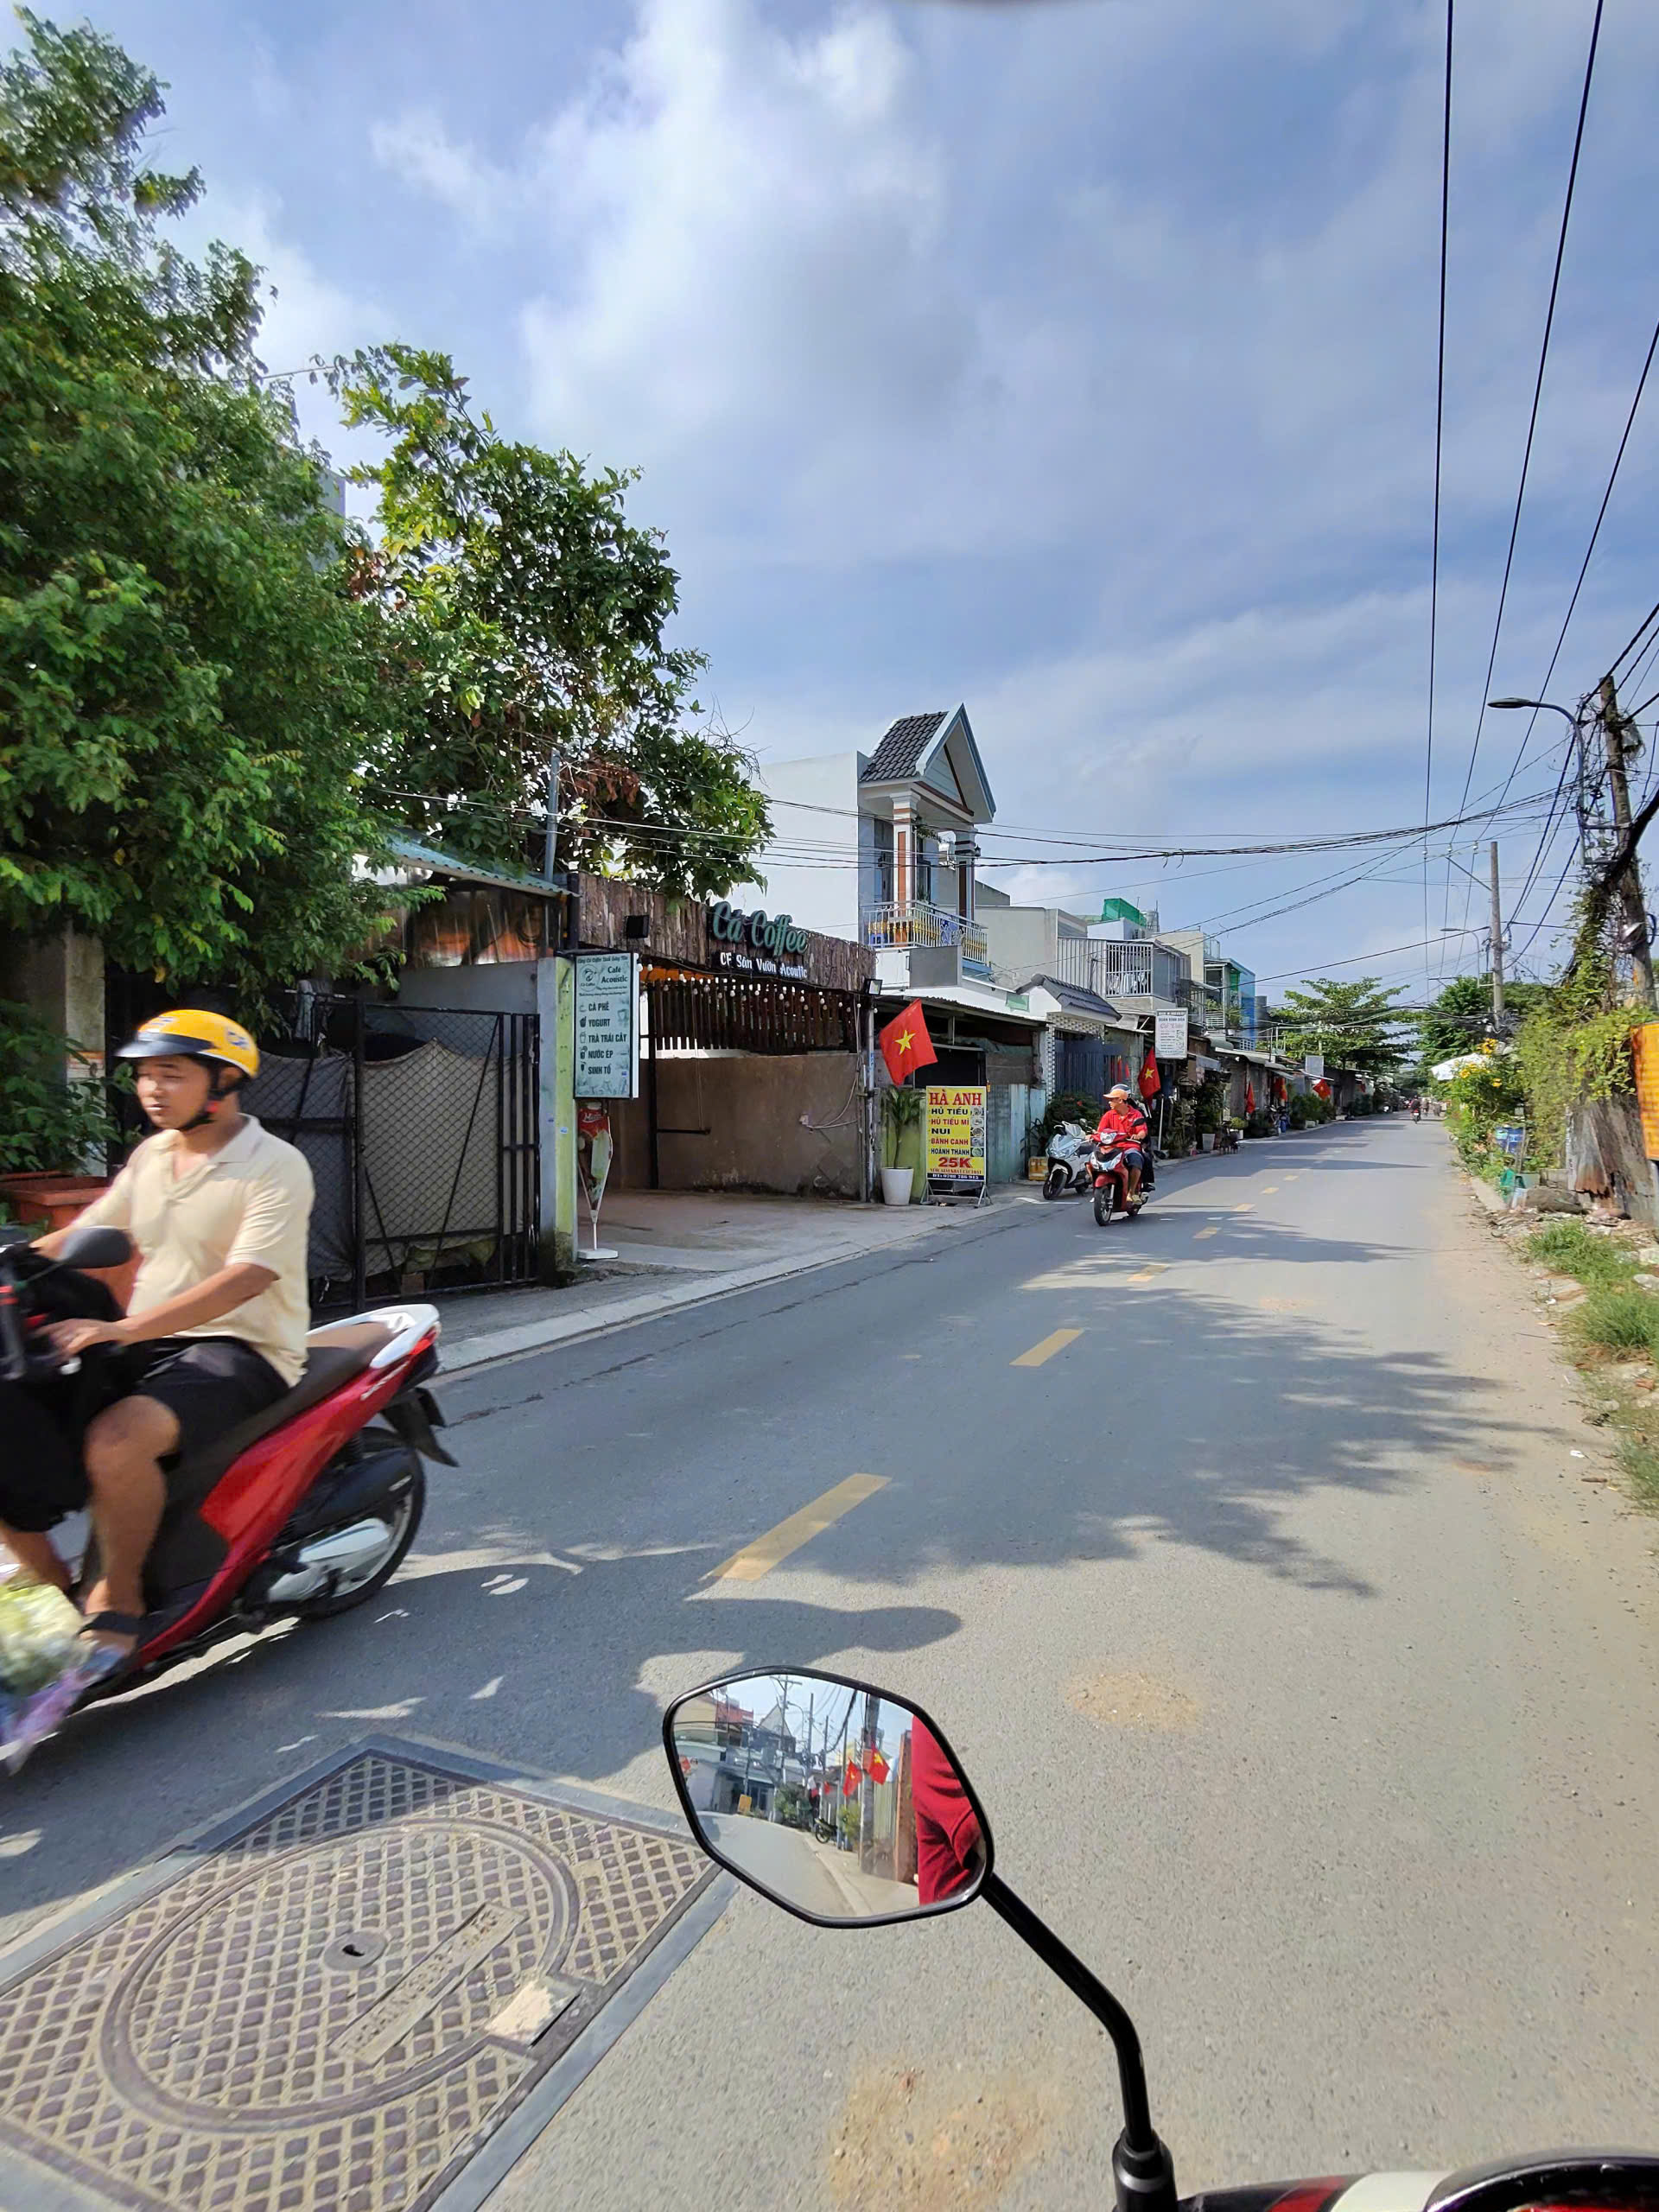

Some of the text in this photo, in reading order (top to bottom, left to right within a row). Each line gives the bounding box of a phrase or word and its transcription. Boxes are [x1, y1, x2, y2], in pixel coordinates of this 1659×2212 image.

[713, 901, 808, 957] Cá Coffee
[720, 952, 732, 966] CF
[736, 955, 753, 969] Sân
[601, 975, 628, 983] Acoustic
[588, 1001, 610, 1012] CÀ PHÊ
[588, 1019, 610, 1027] YOGURT
[588, 1032, 627, 1043] TRÀ TRÁI CÂY
[588, 1049, 613, 1059] NƯỚC ÉP
[588, 1066, 603, 1075] SINH
[604, 1064, 612, 1074] TỐ
[929, 1090, 982, 1106] HÀ ANH
[938, 1156, 973, 1168] 25K
